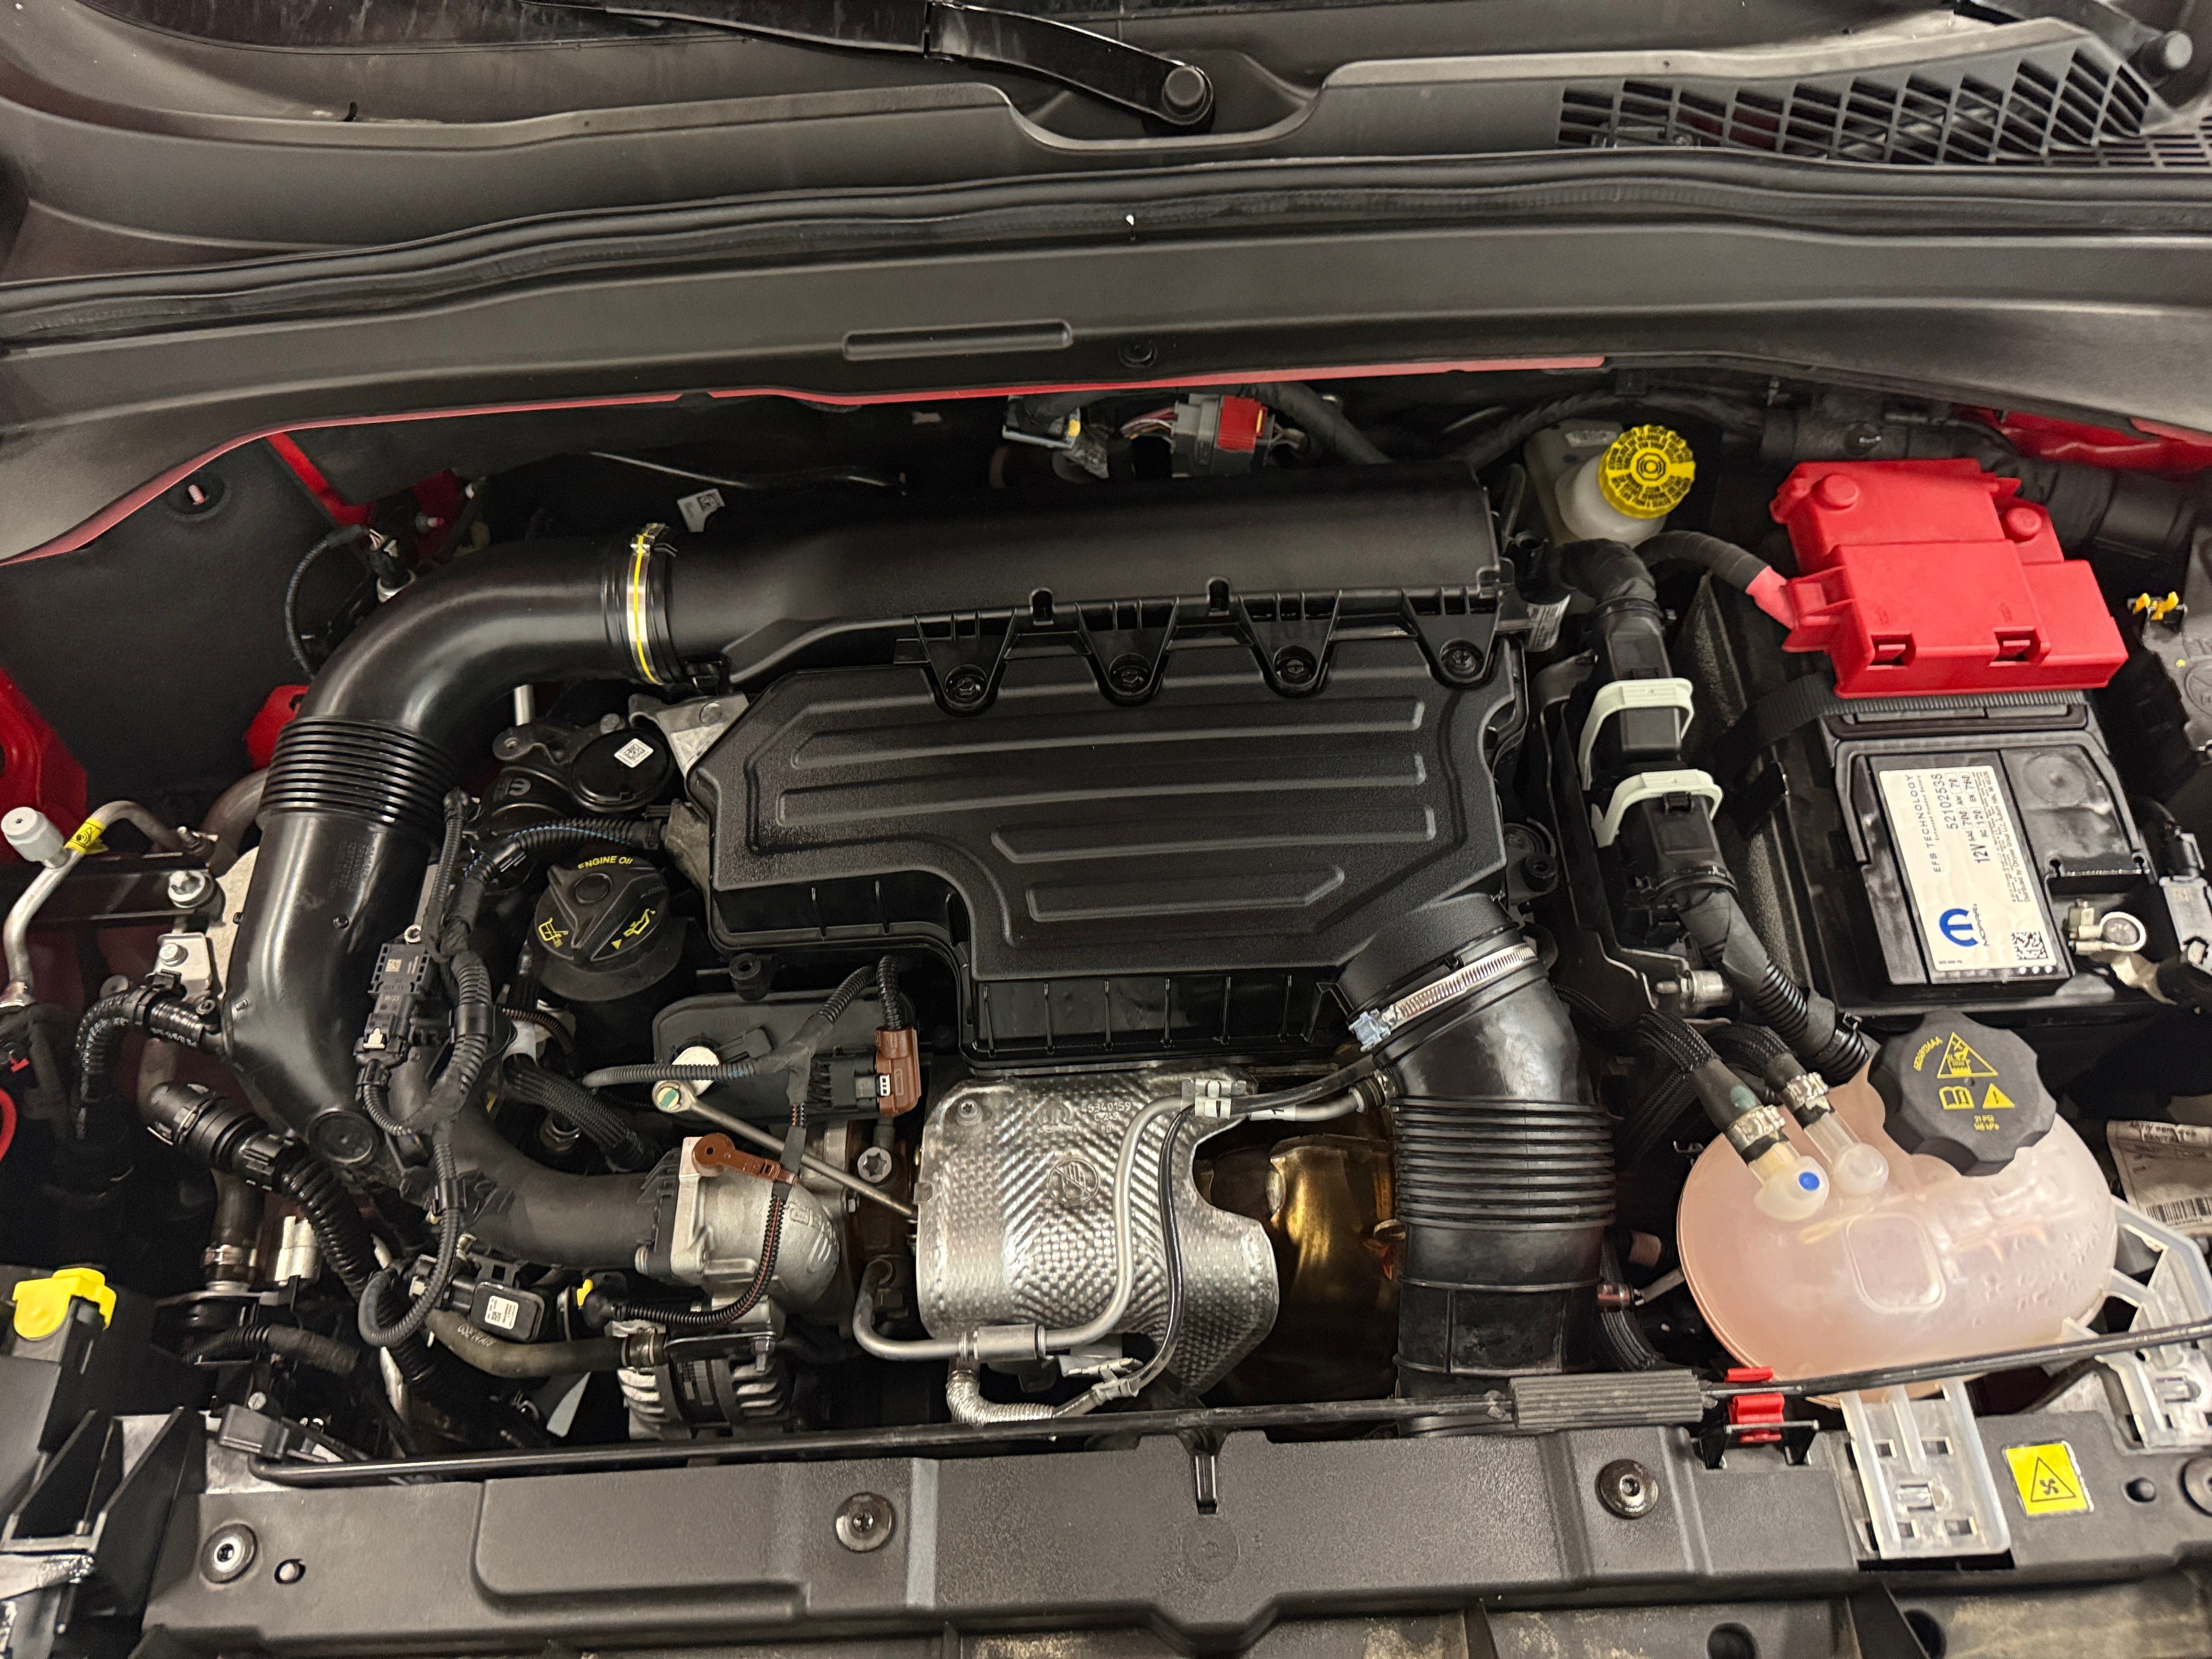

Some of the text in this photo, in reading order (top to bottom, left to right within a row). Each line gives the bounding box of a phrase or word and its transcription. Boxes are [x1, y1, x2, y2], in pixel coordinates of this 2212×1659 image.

[1930, 773, 1959, 830] 52102538
[1905, 774, 1942, 872] EFB TECHNOLOGY
[578, 855, 618, 869] ENGINE
[1969, 843, 1990, 864] 12V
